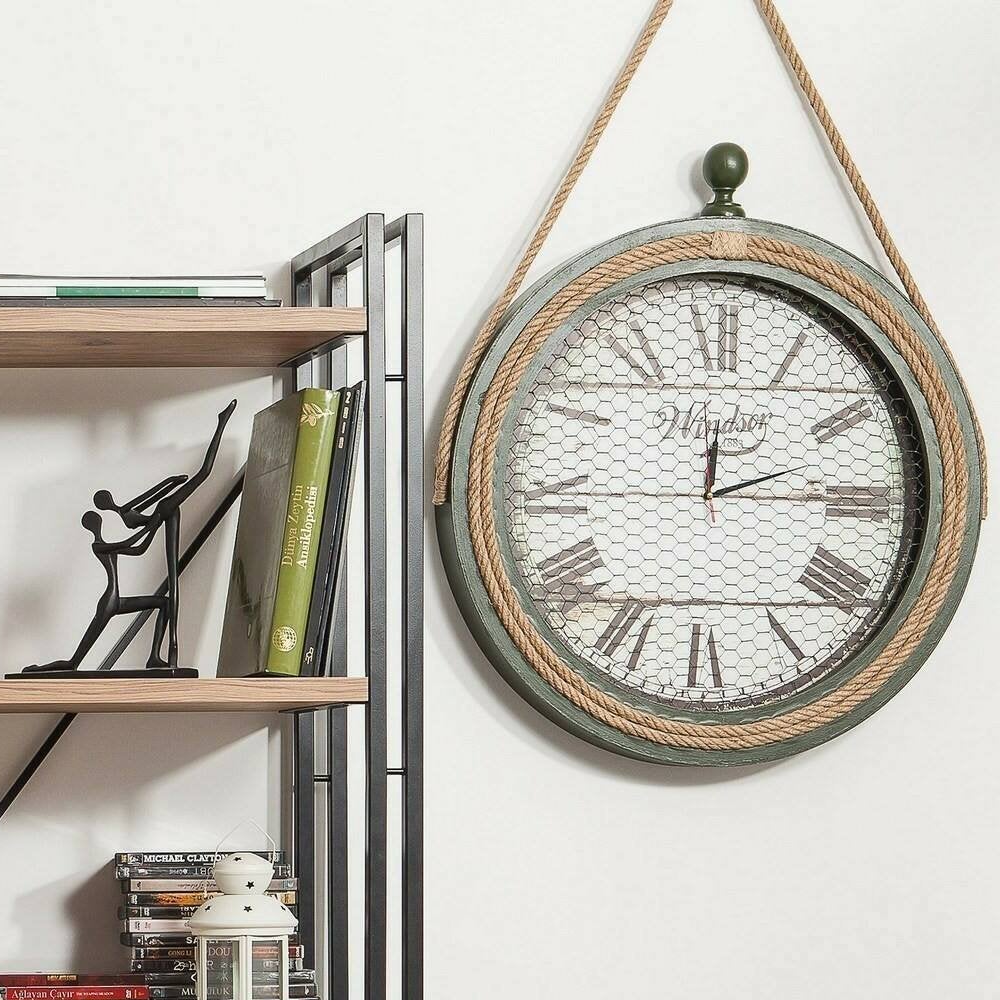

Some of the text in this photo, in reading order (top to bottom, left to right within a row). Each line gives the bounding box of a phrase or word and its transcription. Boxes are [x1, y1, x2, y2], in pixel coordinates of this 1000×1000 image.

[281, 484, 304, 567] Dünya Zeytin
[296, 485, 318, 570] Ansiklopedisi
[144, 855, 185, 863] MICHAEL
[12, 988, 73, 1000] Ağlayan Çayır
